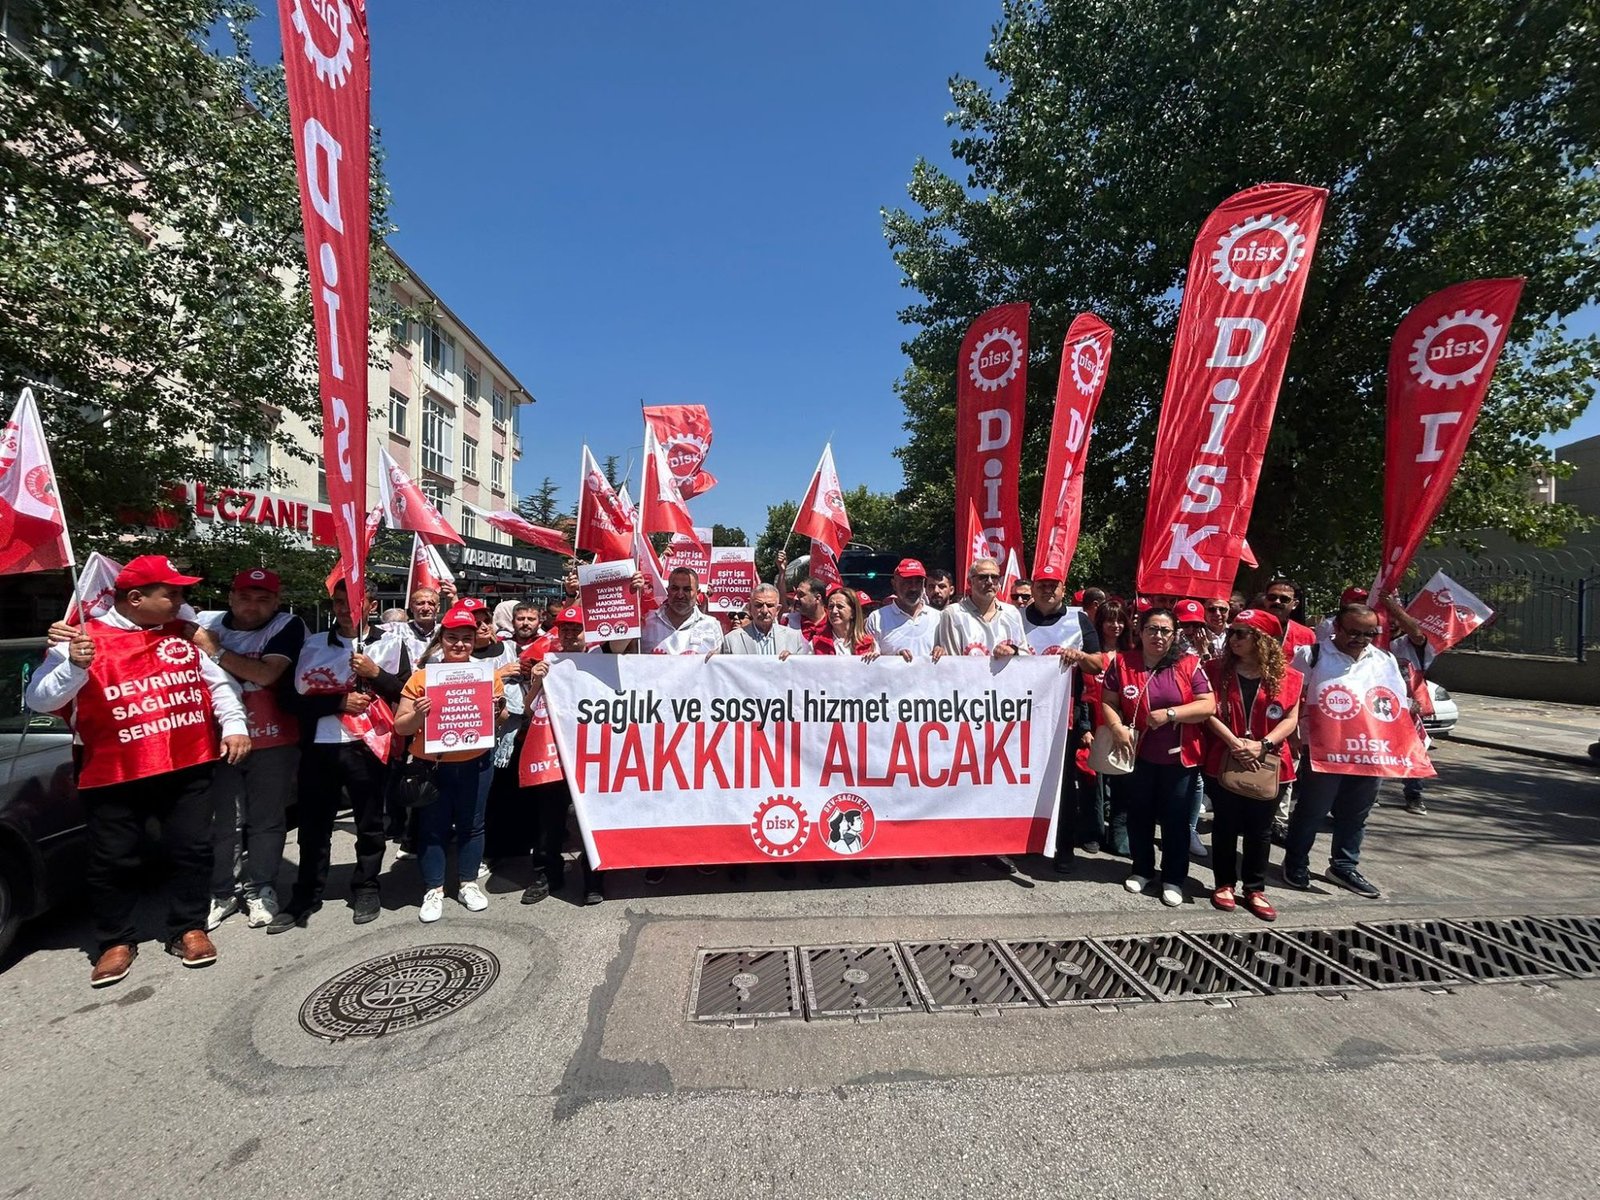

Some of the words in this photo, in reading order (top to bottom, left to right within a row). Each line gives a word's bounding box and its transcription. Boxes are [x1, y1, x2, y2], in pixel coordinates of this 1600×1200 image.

[1232, 240, 1284, 264] DİSK
[1428, 337, 1485, 362] DİSK
[980, 349, 1011, 369] DİSK
[1160, 316, 1268, 573] DİSK
[669, 450, 701, 468] DİSK
[977, 408, 1012, 566] DİS
[676, 550, 691, 559] EŞİT
[686, 558, 708, 568] ÜCRET
[718, 569, 732, 578] EŞİT
[734, 569, 745, 578] İŞE
[728, 577, 751, 585] ÜCRET
[713, 585, 751, 593] STİYORUZ!
[588, 607, 607, 615] YASAL
[103, 666, 200, 701] DEVRİMCİ
[112, 686, 203, 721] SAĞLIK-İŞ
[448, 696, 471, 704] DEĞİL
[1328, 695, 1350, 706] DİSK
[440, 712, 480, 722] YAŞAMAK
[577, 689, 661, 734] sağlık
[671, 698, 702, 722] ve
[710, 689, 795, 732] sosyal
[804, 689, 890, 723] hizmet
[900, 689, 1033, 730] emekçileri
[118, 709, 206, 744] SENDİKASI
[1345, 733, 1392, 753] DİSK
[577, 721, 800, 793] HAKKINI
[819, 721, 1031, 788] ALACAK!
[1327, 753, 1351, 763] DEV
[530, 760, 551, 773] DEV
[766, 815, 795, 830] DİSK
[366, 979, 441, 997] ABB
